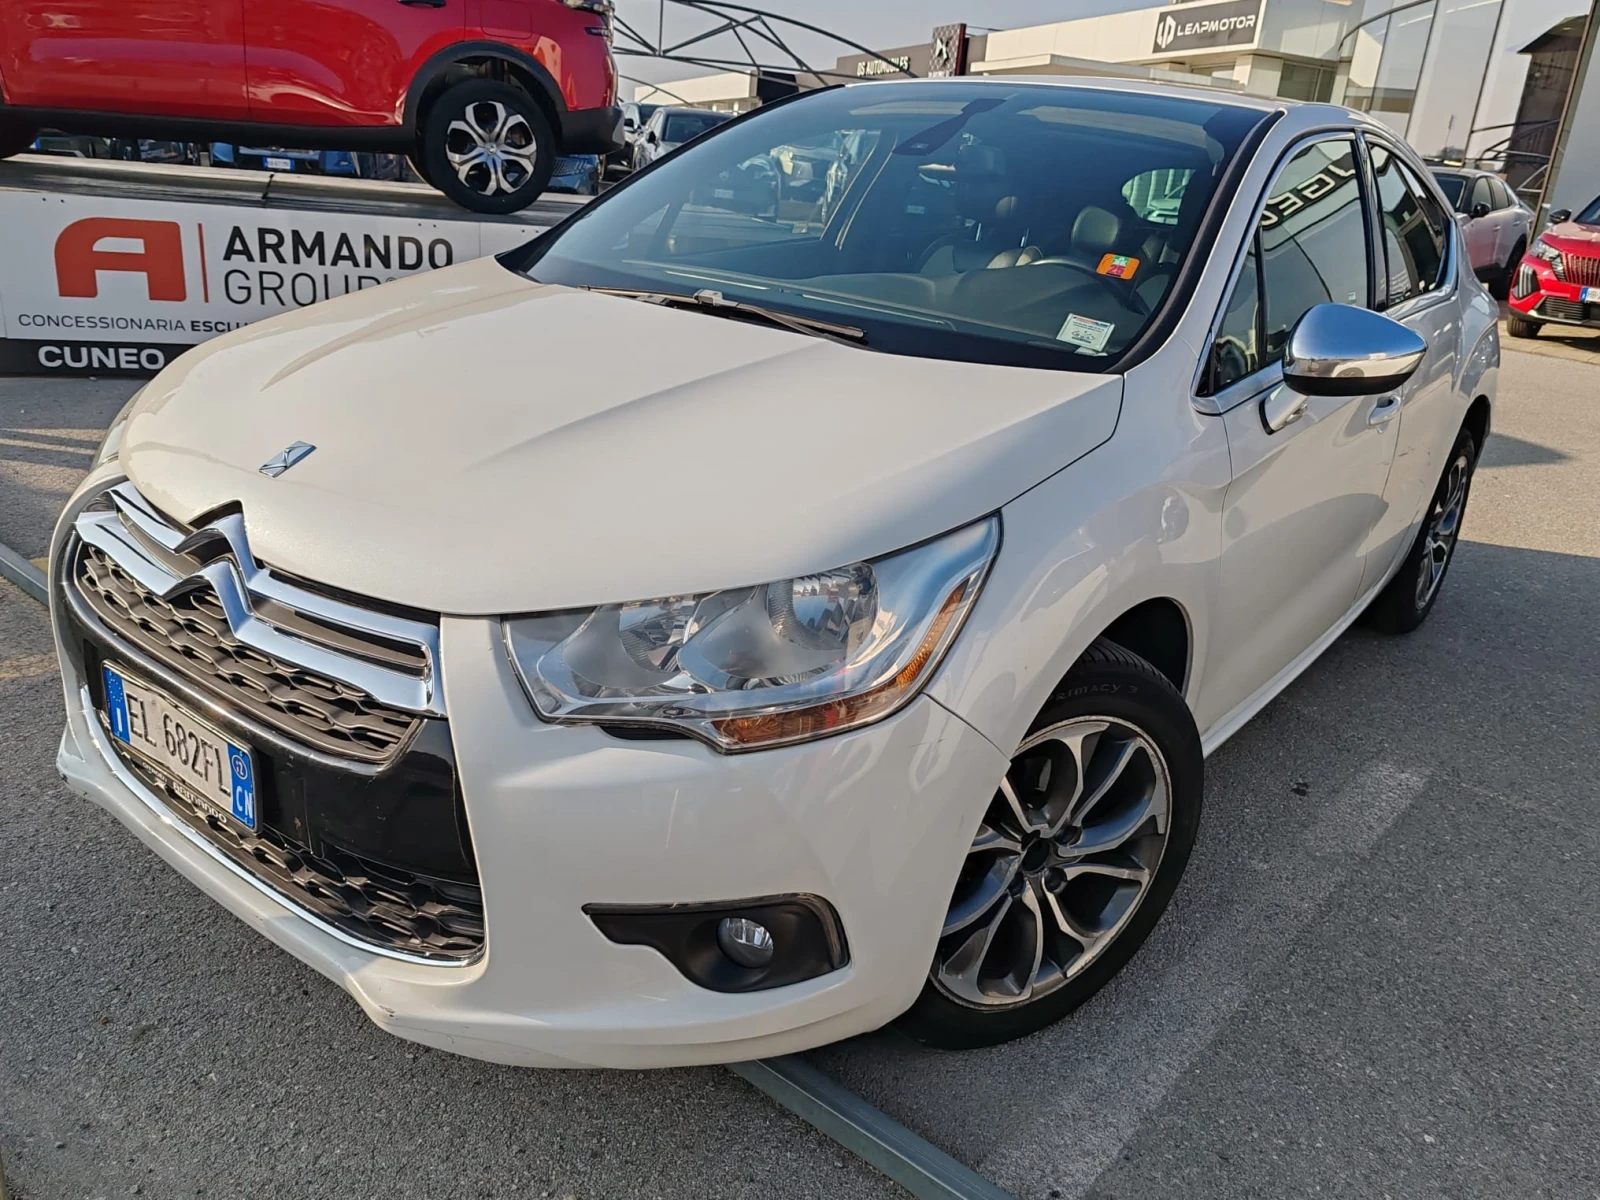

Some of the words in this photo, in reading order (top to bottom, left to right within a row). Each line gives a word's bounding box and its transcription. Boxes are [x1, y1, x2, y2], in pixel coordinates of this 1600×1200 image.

[1177, 15, 1256, 36] LEAPMOTOR
[223, 226, 453, 270] ARMANDO
[19, 314, 186, 331] CONCESSIONARIA
[38, 346, 165, 370] CUNEO
[126, 693, 157, 747] EL
[163, 713, 231, 797] 682FL
[236, 786, 254, 819] CN
